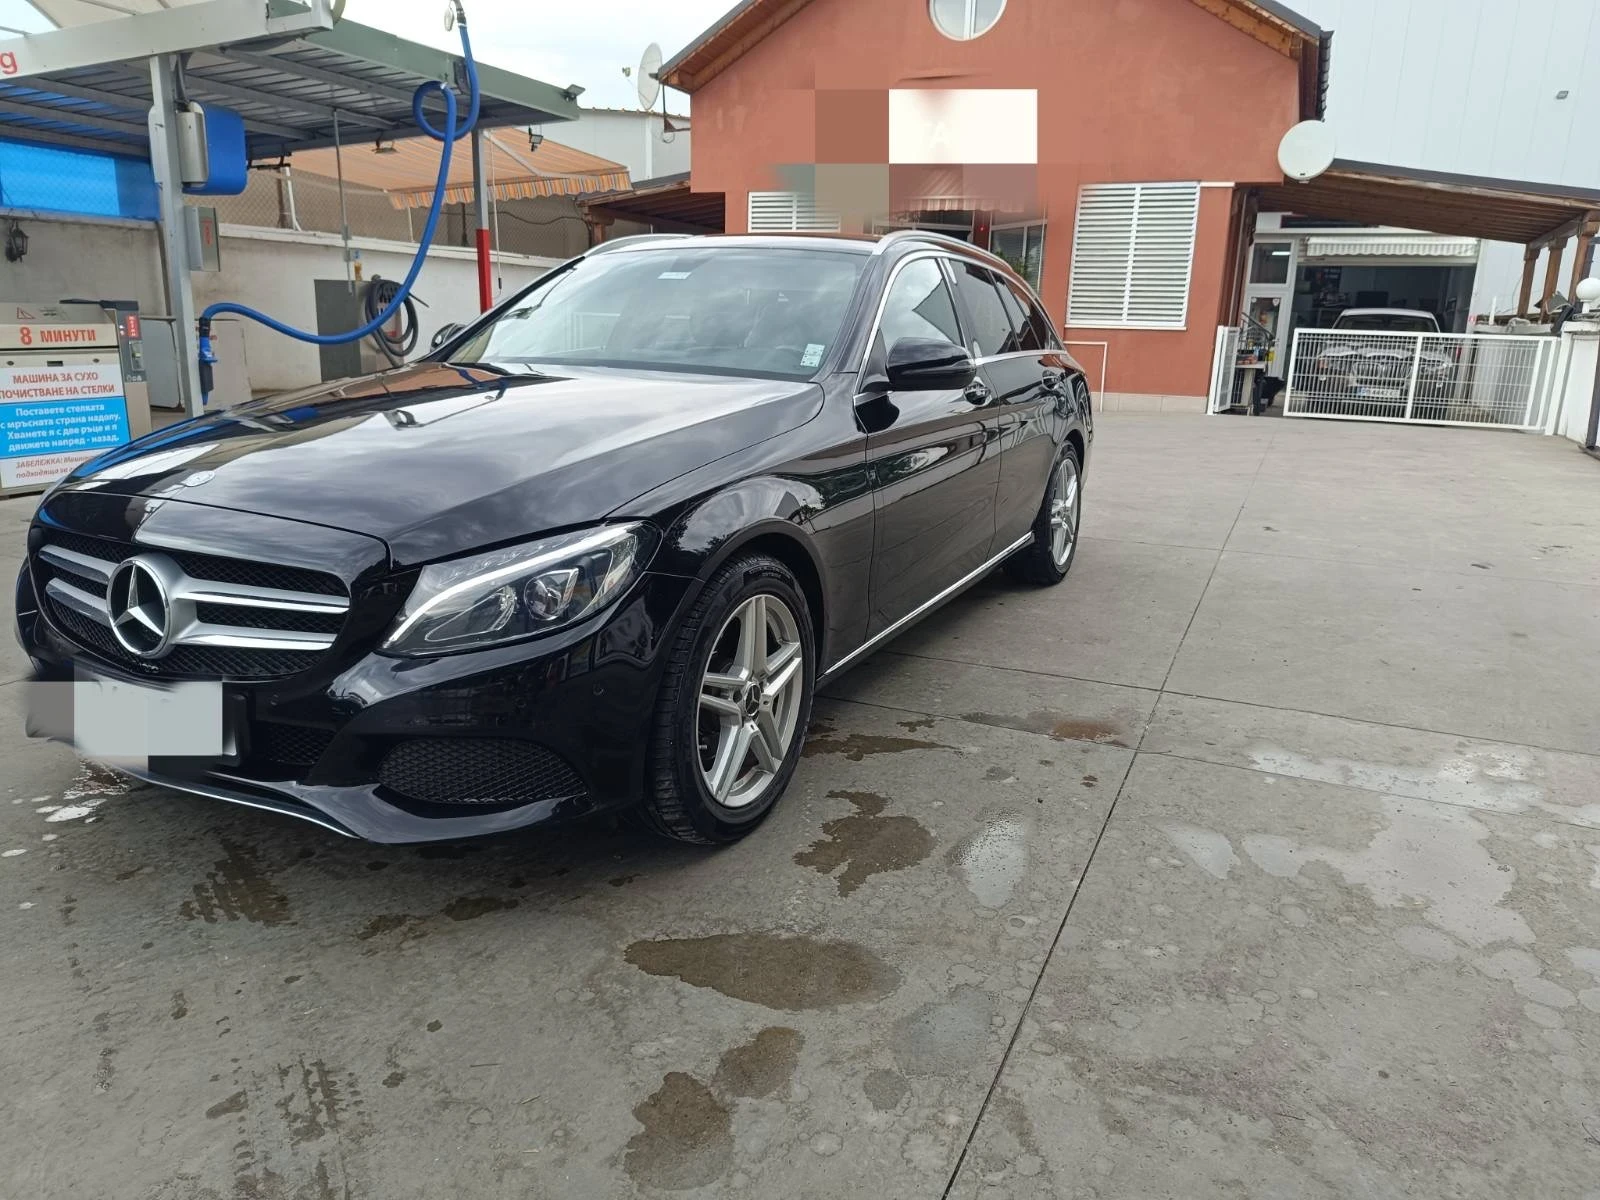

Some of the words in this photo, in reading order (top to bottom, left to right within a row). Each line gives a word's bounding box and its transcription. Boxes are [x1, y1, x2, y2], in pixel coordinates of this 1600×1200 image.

[20, 327, 32, 346] 8
[40, 329, 96, 343] МИНУТИ
[13, 373, 59, 384] МАШИНА
[61, 373, 73, 381] ЗА
[74, 371, 98, 381] СУХО
[0, 386, 64, 398] ПОЧИСТВАНЕ
[66, 387, 79, 395] НА
[80, 384, 115, 394] СТЕЛКИ
[16, 407, 64, 417] Поставете
[66, 404, 105, 413] стелката
[7, 419, 54, 429] мръсната
[56, 417, 86, 426] страна
[88, 413, 121, 422] надолу.
[8, 430, 47, 440] Хванете
[81, 426, 103, 434] ръце
[9, 443, 51, 452] движете
[52, 439, 86, 447] напред
[92, 435, 120, 443] назад.
[16, 458, 62, 469] ЗАБЕЛЕЖКА!
